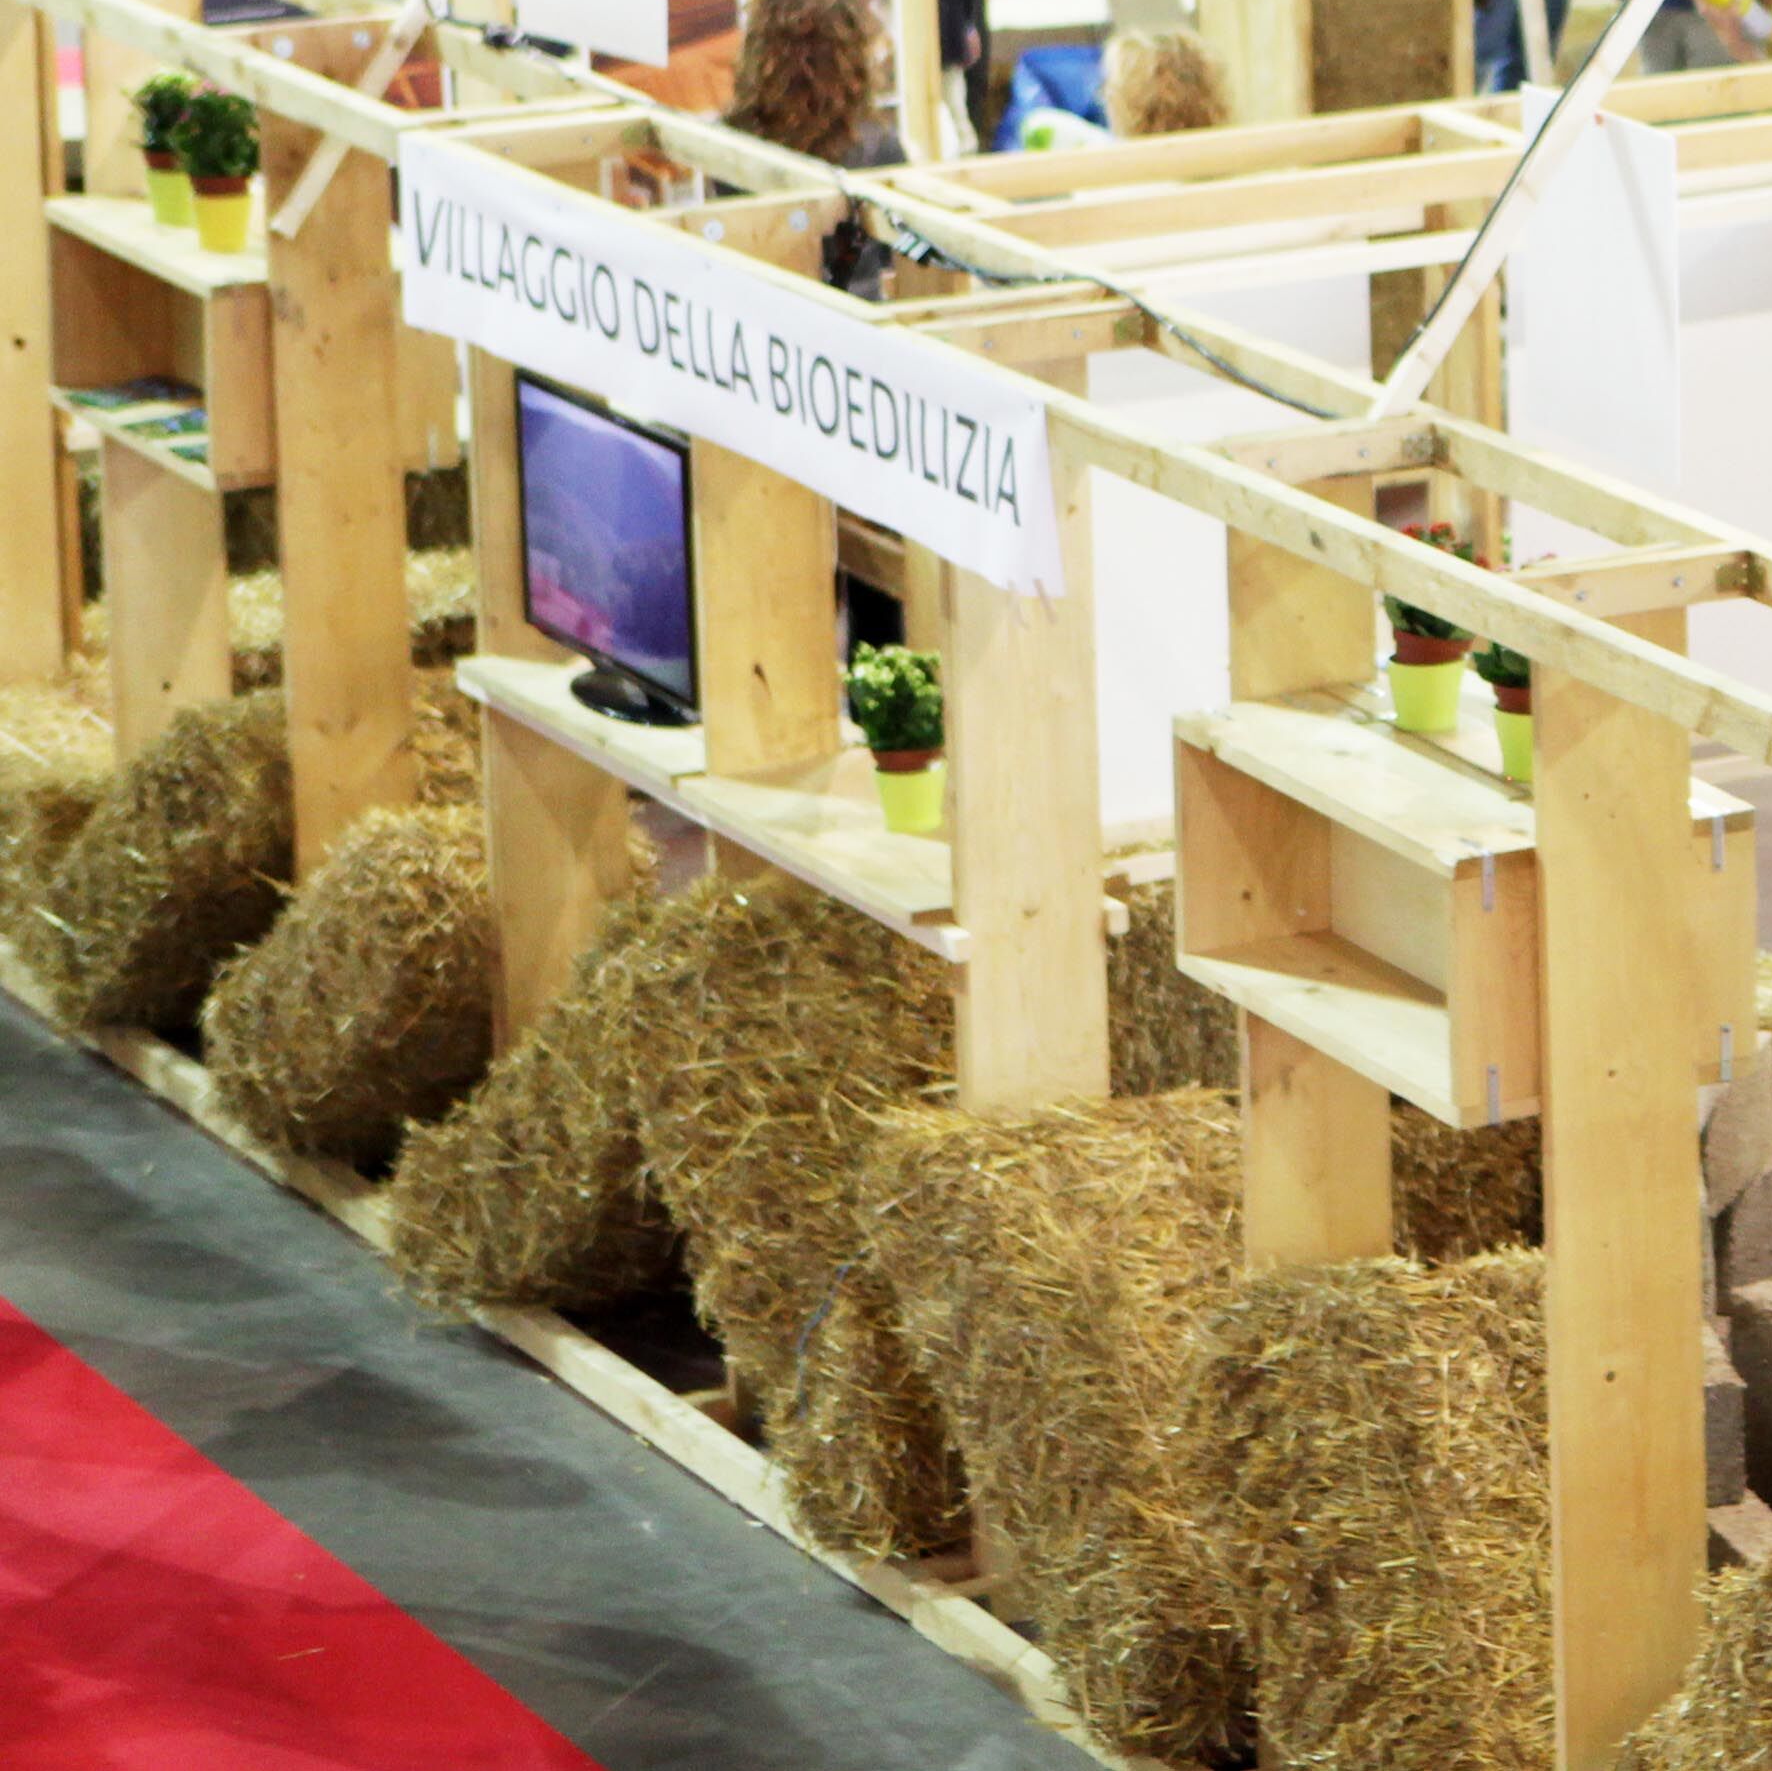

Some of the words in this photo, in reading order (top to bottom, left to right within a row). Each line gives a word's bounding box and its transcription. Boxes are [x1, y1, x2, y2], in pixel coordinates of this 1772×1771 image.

[413, 189, 621, 341] VILLAGGIO
[632, 278, 759, 404] DELLA
[768, 333, 1021, 527] BIOEDILIZIA
